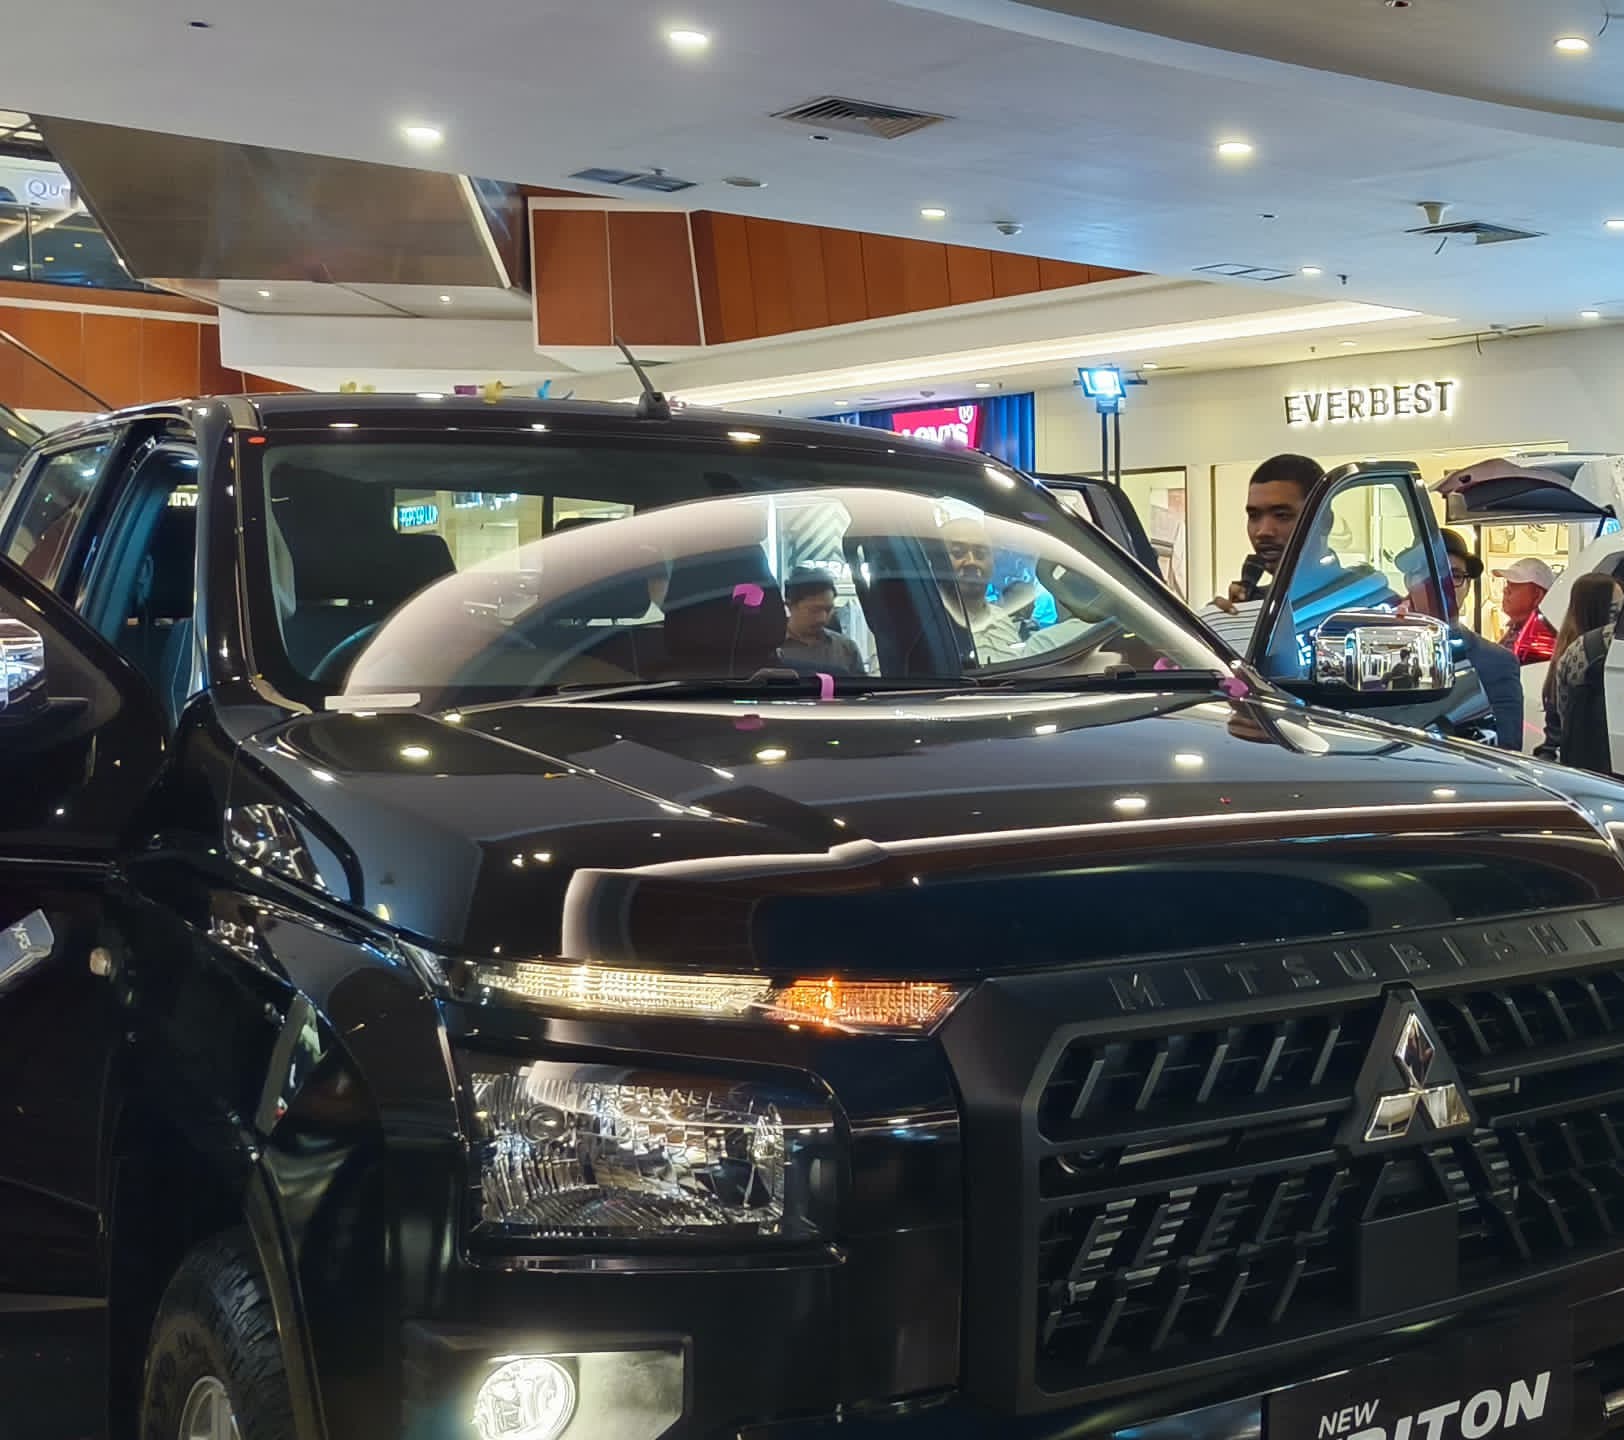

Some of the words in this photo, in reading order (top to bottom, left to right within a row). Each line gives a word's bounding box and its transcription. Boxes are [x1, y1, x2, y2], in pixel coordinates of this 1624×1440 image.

[1283, 381, 1453, 425] EVERBEST
[1107, 918, 1604, 1012] MITSUBISHI
[1318, 1399, 1380, 1439] NEW
